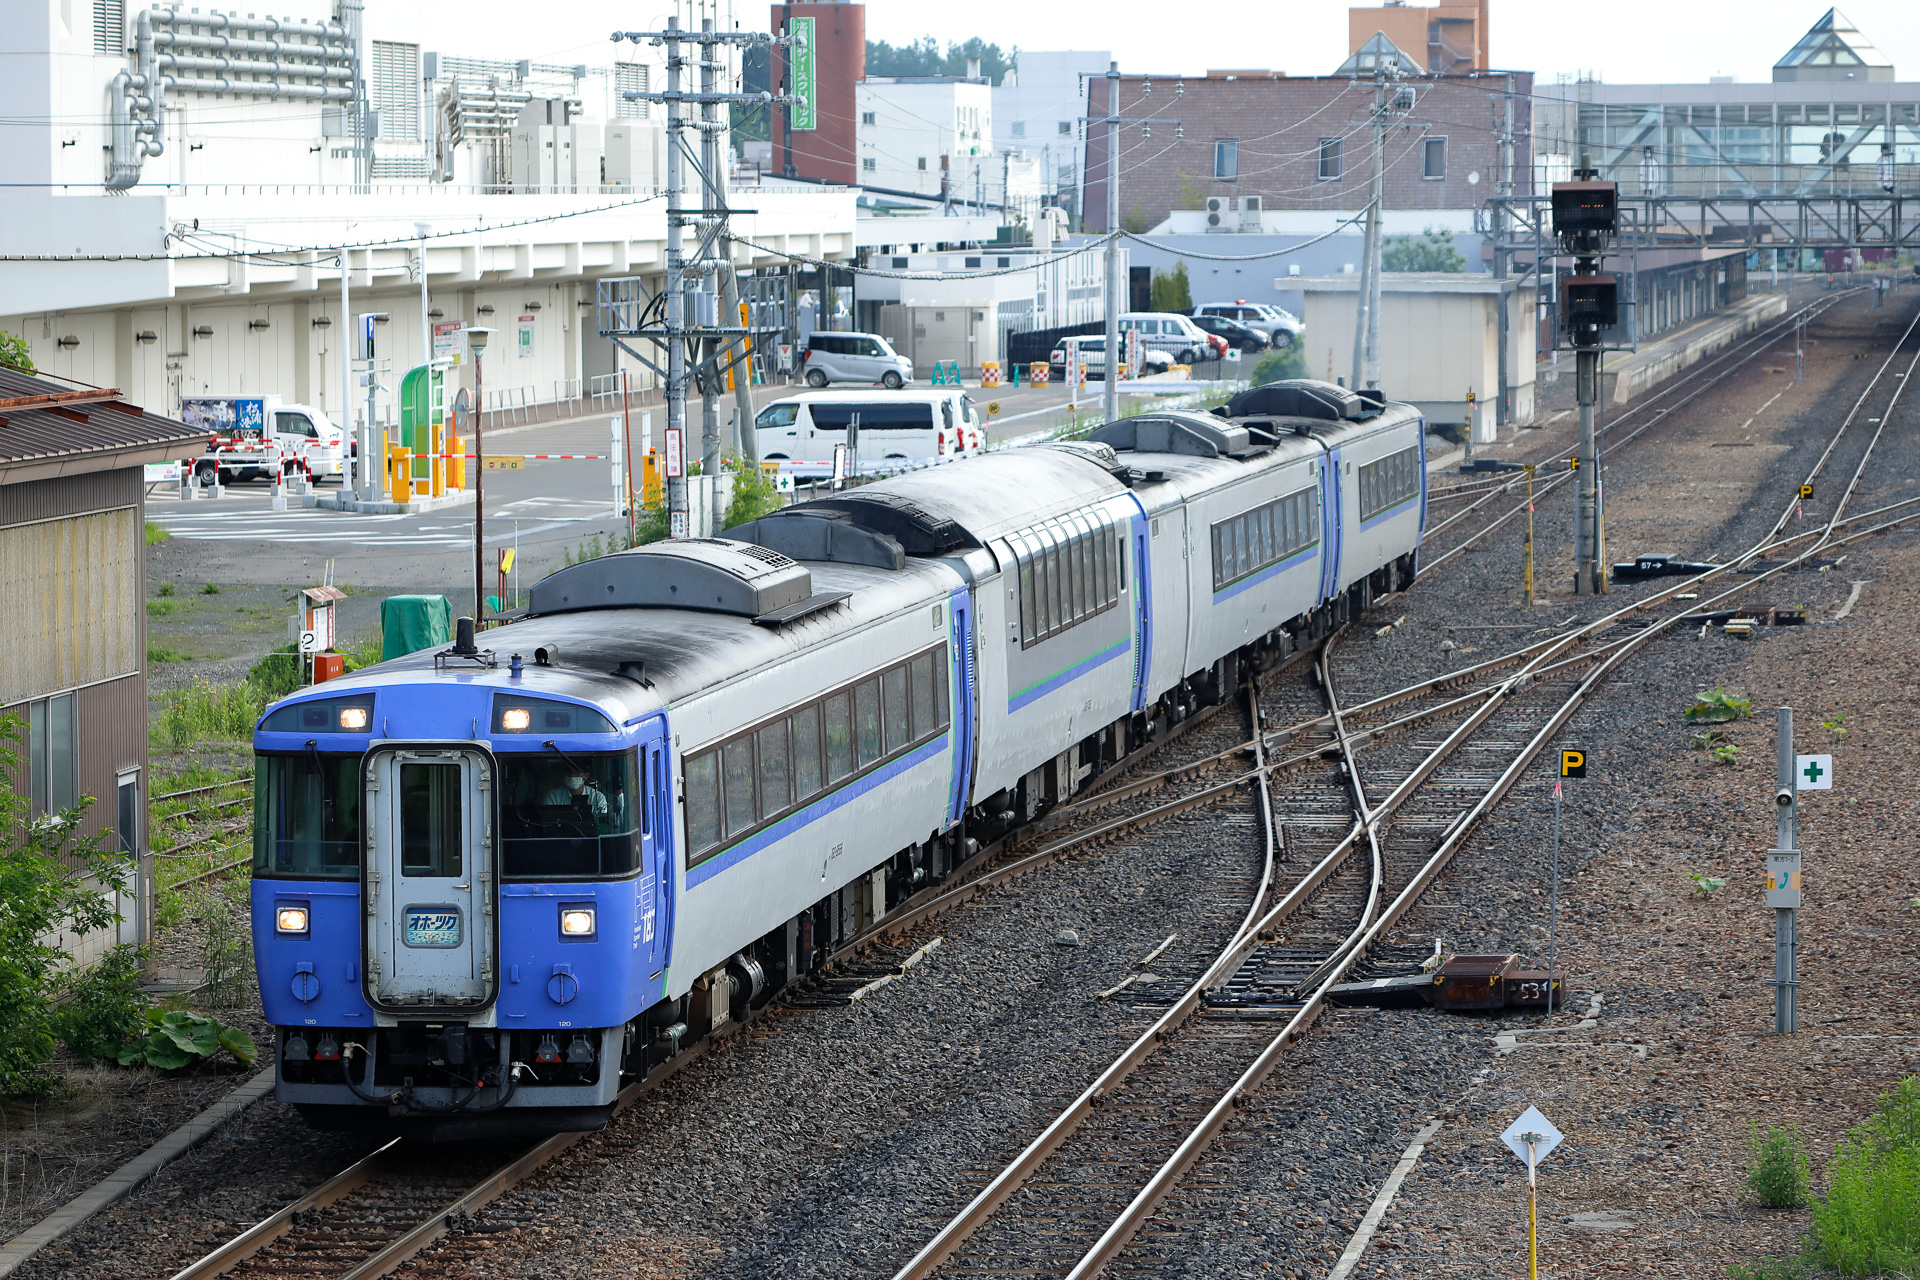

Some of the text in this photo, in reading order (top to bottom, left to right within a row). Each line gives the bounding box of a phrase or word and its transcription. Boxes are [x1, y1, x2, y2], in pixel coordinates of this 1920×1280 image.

[1467, 393, 1475, 402] P
[1801, 485, 1813, 499] P
[302, 633, 315, 650] 2
[1562, 751, 1584, 776] P
[408, 915, 458, 931] オホーツク
